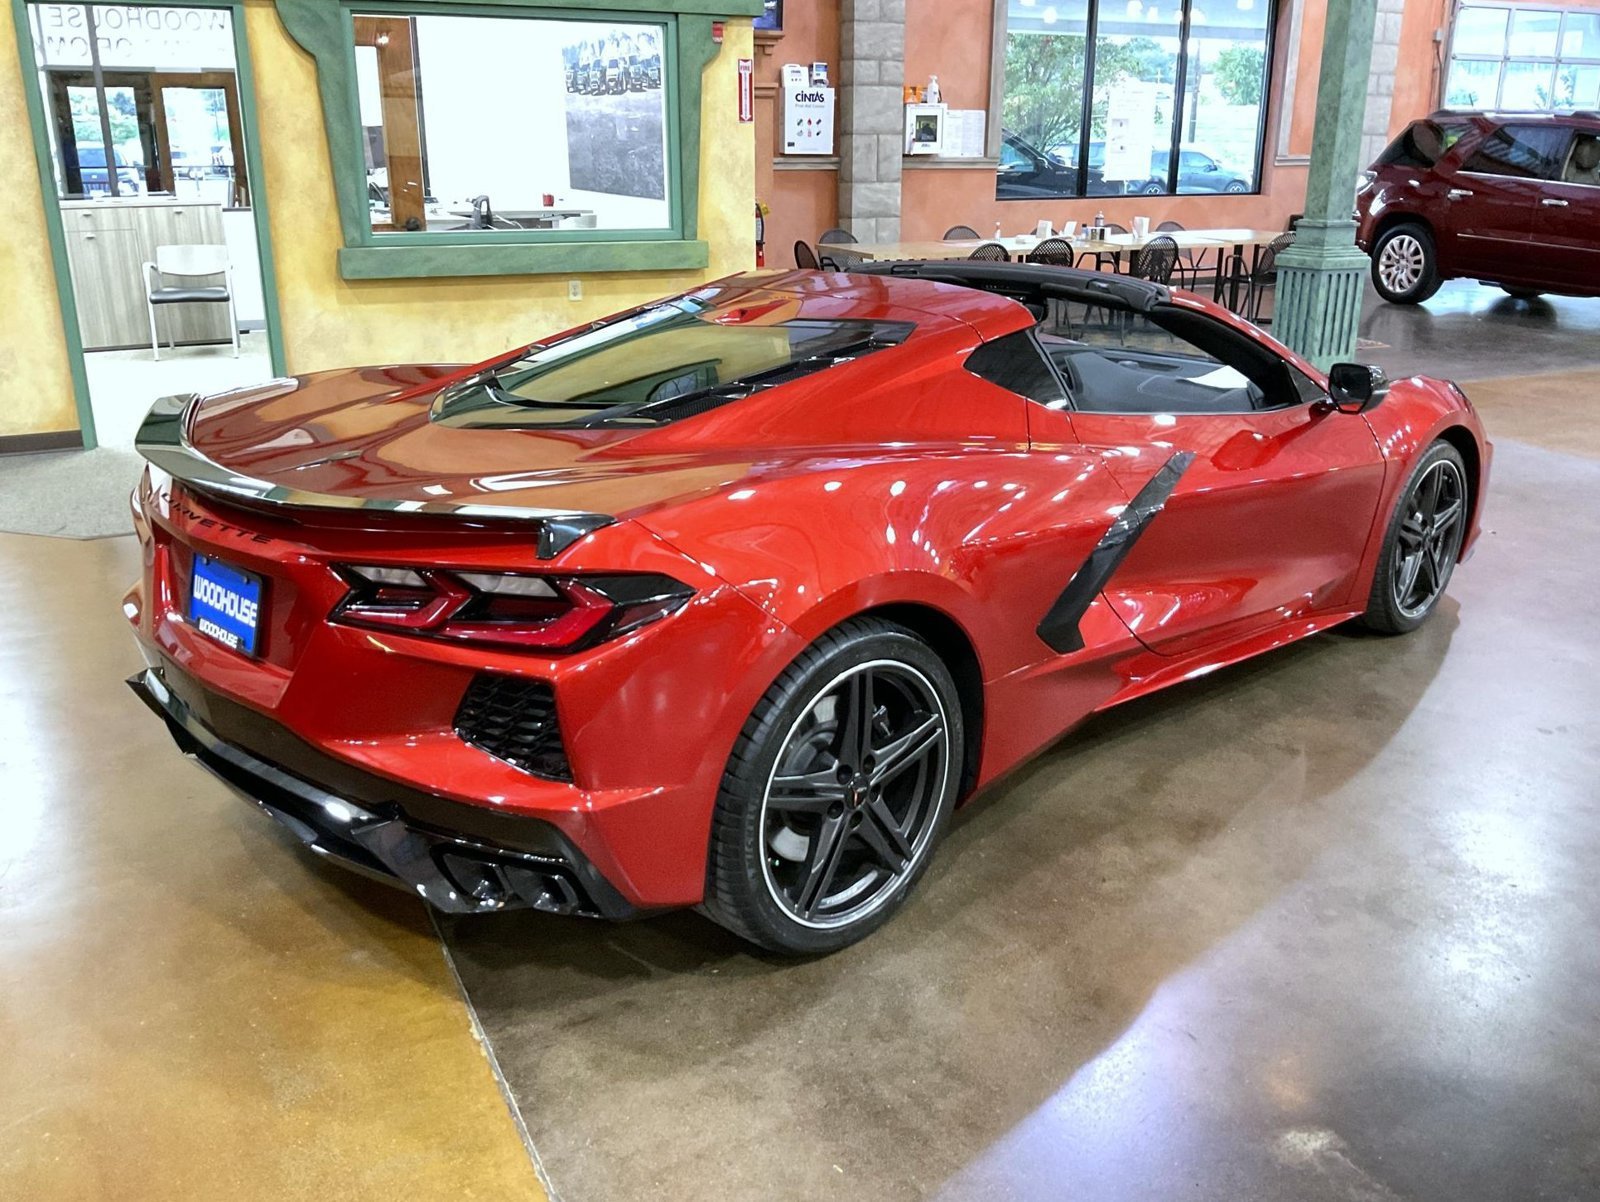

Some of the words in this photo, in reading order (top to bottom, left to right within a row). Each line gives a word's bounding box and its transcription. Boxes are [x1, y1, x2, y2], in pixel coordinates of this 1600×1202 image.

[795, 90, 825, 103] CINTAS
[193, 574, 258, 628] WOODHOUSE
[199, 618, 238, 649] WOODHOUSE
